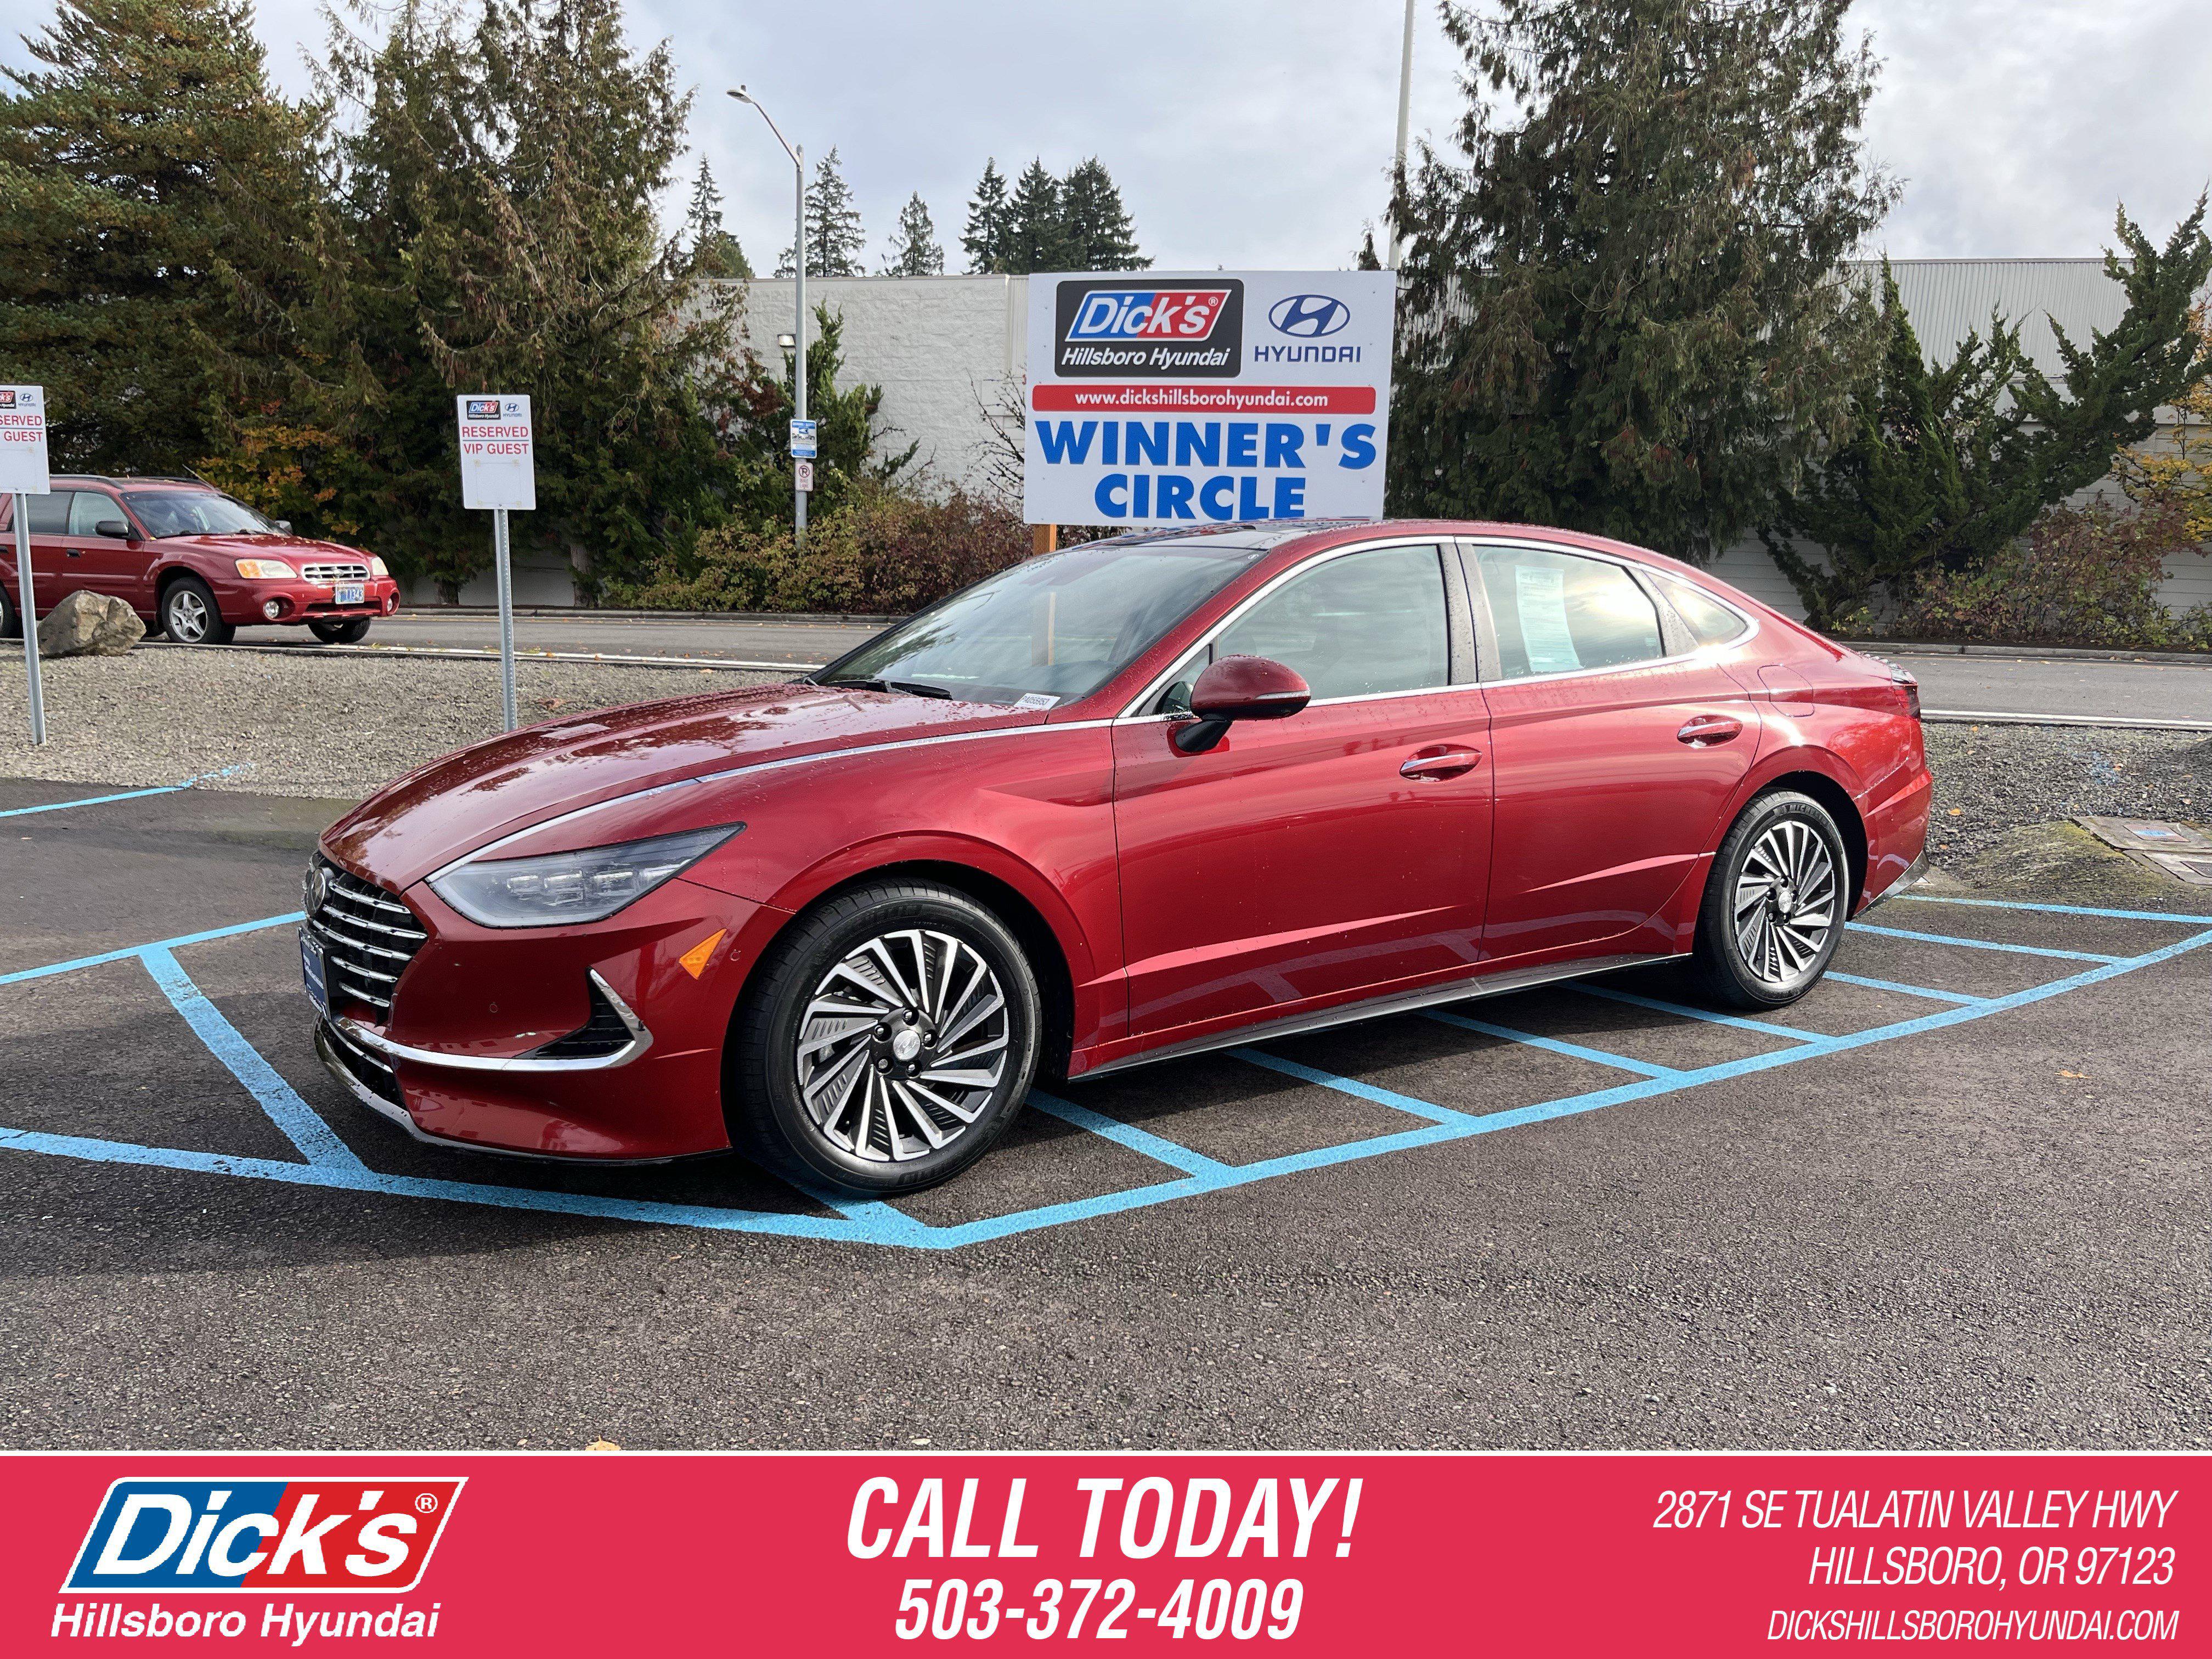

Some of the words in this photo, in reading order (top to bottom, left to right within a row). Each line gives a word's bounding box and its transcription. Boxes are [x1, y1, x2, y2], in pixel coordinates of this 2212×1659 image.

[1079, 295, 1209, 335] Dick's
[1062, 347, 1146, 365] Hillsboro
[1149, 348, 1231, 370] Hyundai
[1254, 346, 1361, 363] HYUNDAI
[1074, 388, 1328, 410] www.dickshillsborohyundai.com
[4, 431, 42, 442] GUEST
[462, 426, 528, 438] RESERVED
[464, 443, 483, 454] VIP
[487, 443, 529, 455] GUEST
[1035, 420, 1376, 469] WINNER'S
[1094, 473, 1306, 521] CIRCLE
